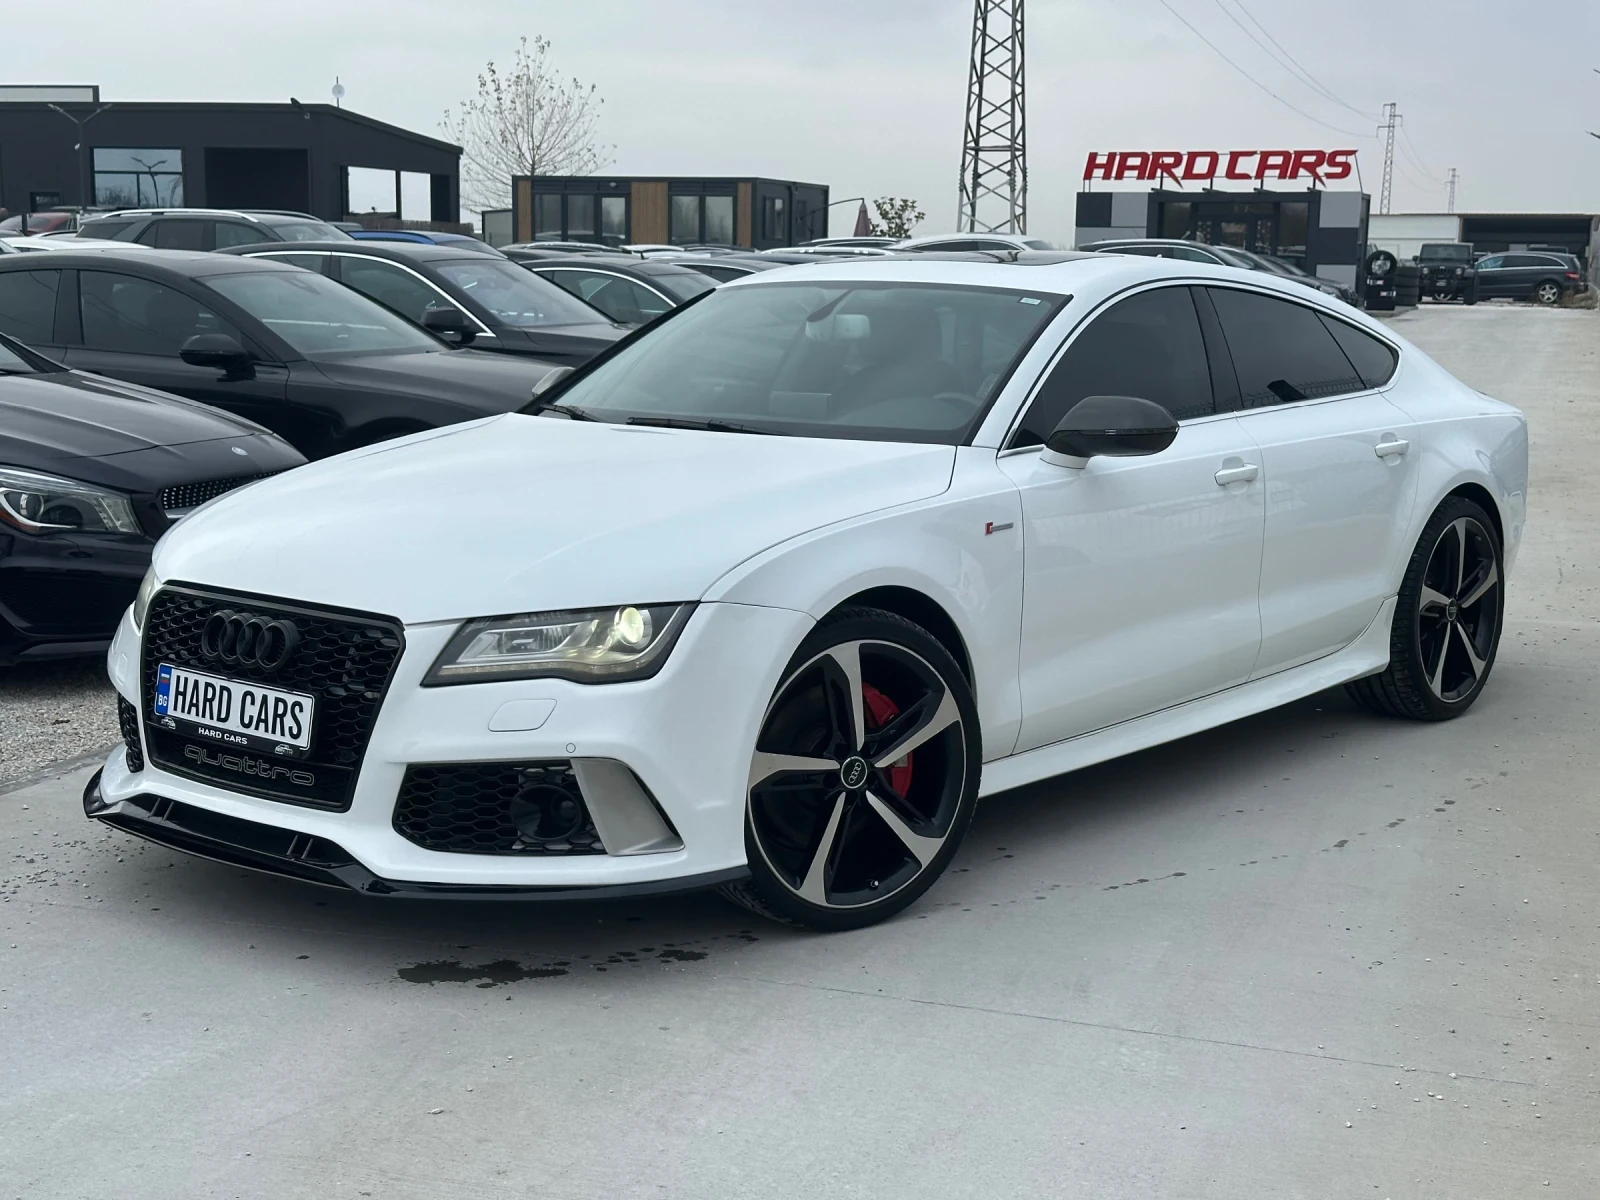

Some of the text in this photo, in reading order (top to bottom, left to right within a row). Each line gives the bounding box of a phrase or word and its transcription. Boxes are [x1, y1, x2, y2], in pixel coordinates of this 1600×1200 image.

[1083, 150, 1358, 189] HARD CARS
[158, 694, 168, 707] BG
[173, 675, 304, 740] HARD CARS
[198, 727, 248, 745] HARD CARS
[184, 744, 314, 786] quattro
